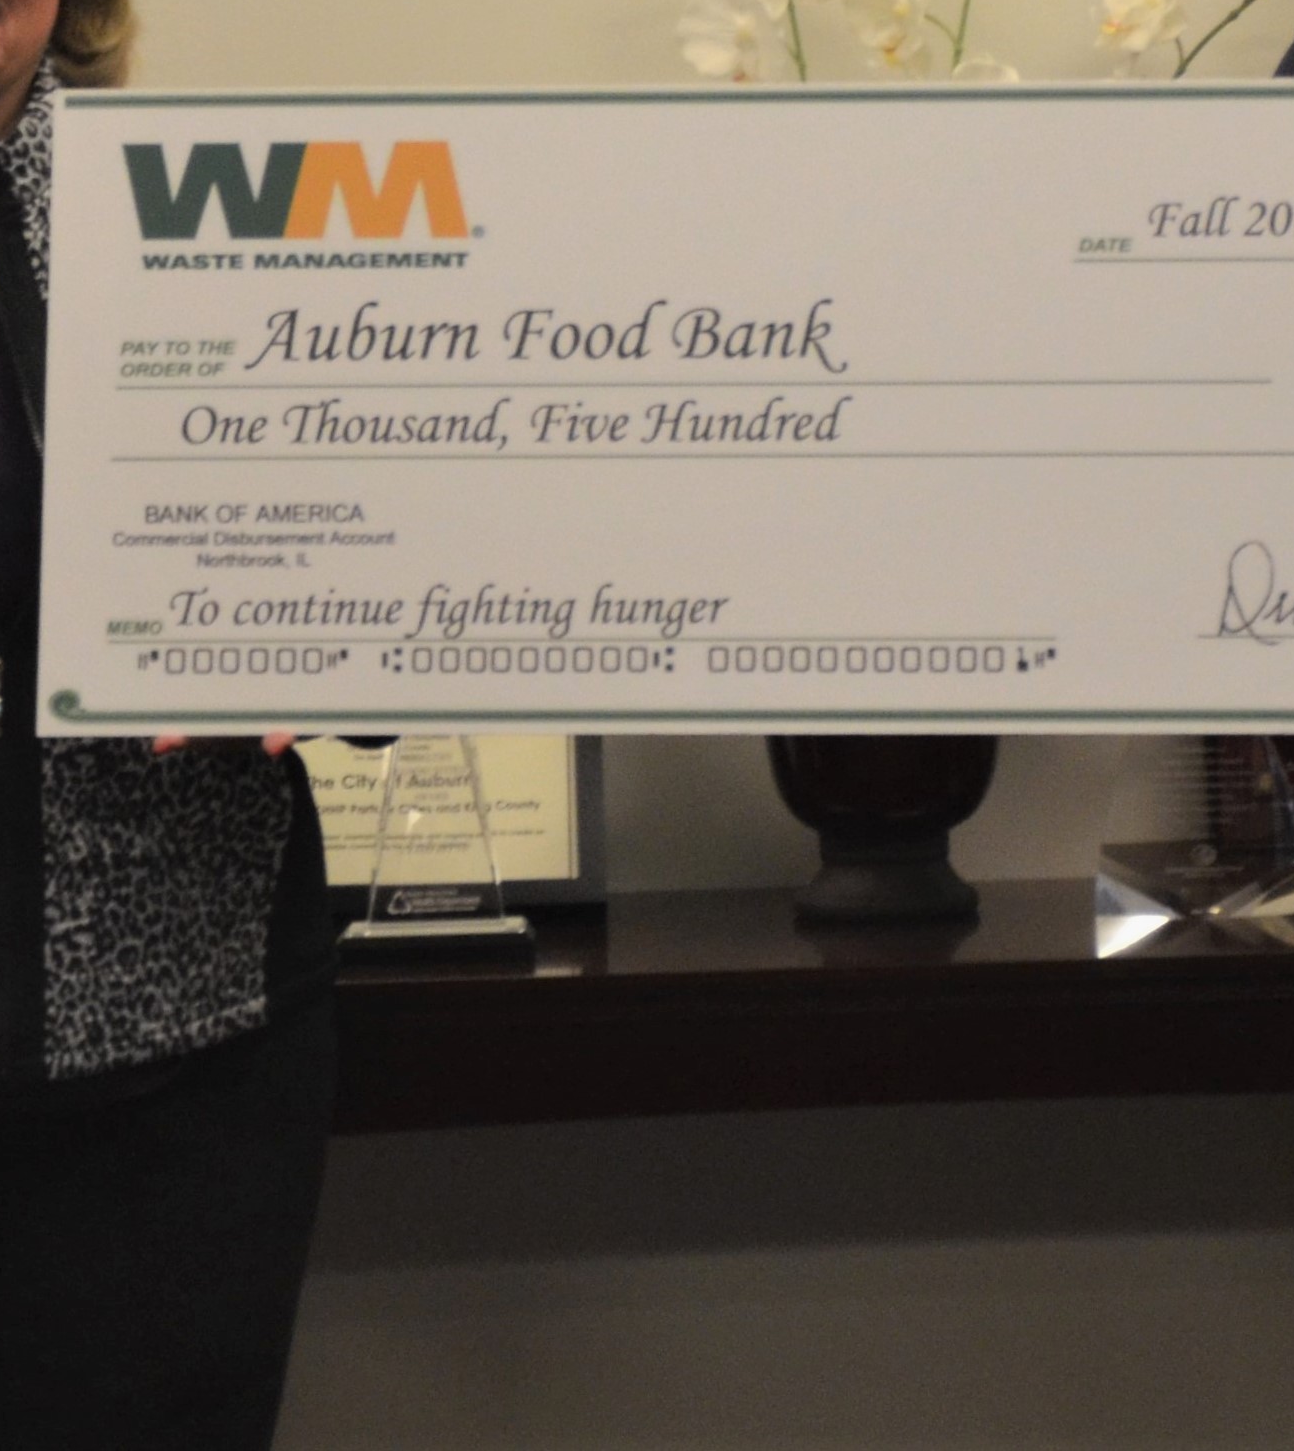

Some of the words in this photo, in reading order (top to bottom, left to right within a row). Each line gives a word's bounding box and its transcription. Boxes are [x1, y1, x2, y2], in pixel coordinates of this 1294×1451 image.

[122, 140, 470, 241] WM
[1078, 237, 1132, 254] DATE
[1147, 197, 1238, 240] Fall
[142, 253, 244, 270] WASTE
[253, 251, 469, 269] MANAGEMENT
[244, 301, 481, 370] Auburn
[502, 300, 667, 362] Food
[671, 299, 848, 374] Bank
[120, 340, 165, 357] PAY
[167, 340, 193, 356] TO
[197, 339, 236, 356] THE
[120, 361, 194, 378] ORDER
[197, 361, 224, 377] OF
[180, 404, 269, 445] One
[282, 398, 512, 450] Thousand,
[531, 399, 630, 444] Five
[640, 396, 854, 444] Hundred
[144, 504, 209, 525] BANK
[215, 504, 249, 524] OF
[255, 503, 366, 524] AMERICA
[111, 531, 208, 546] Commercial
[213, 530, 325, 545] Disbursement
[329, 530, 396, 545] Account
[107, 620, 163, 636] MEMO
[169, 587, 220, 627] To
[233, 587, 405, 627] continue
[404, 583, 577, 640] fighting
[590, 582, 731, 640] hunger
[341, 774, 378, 792] City
